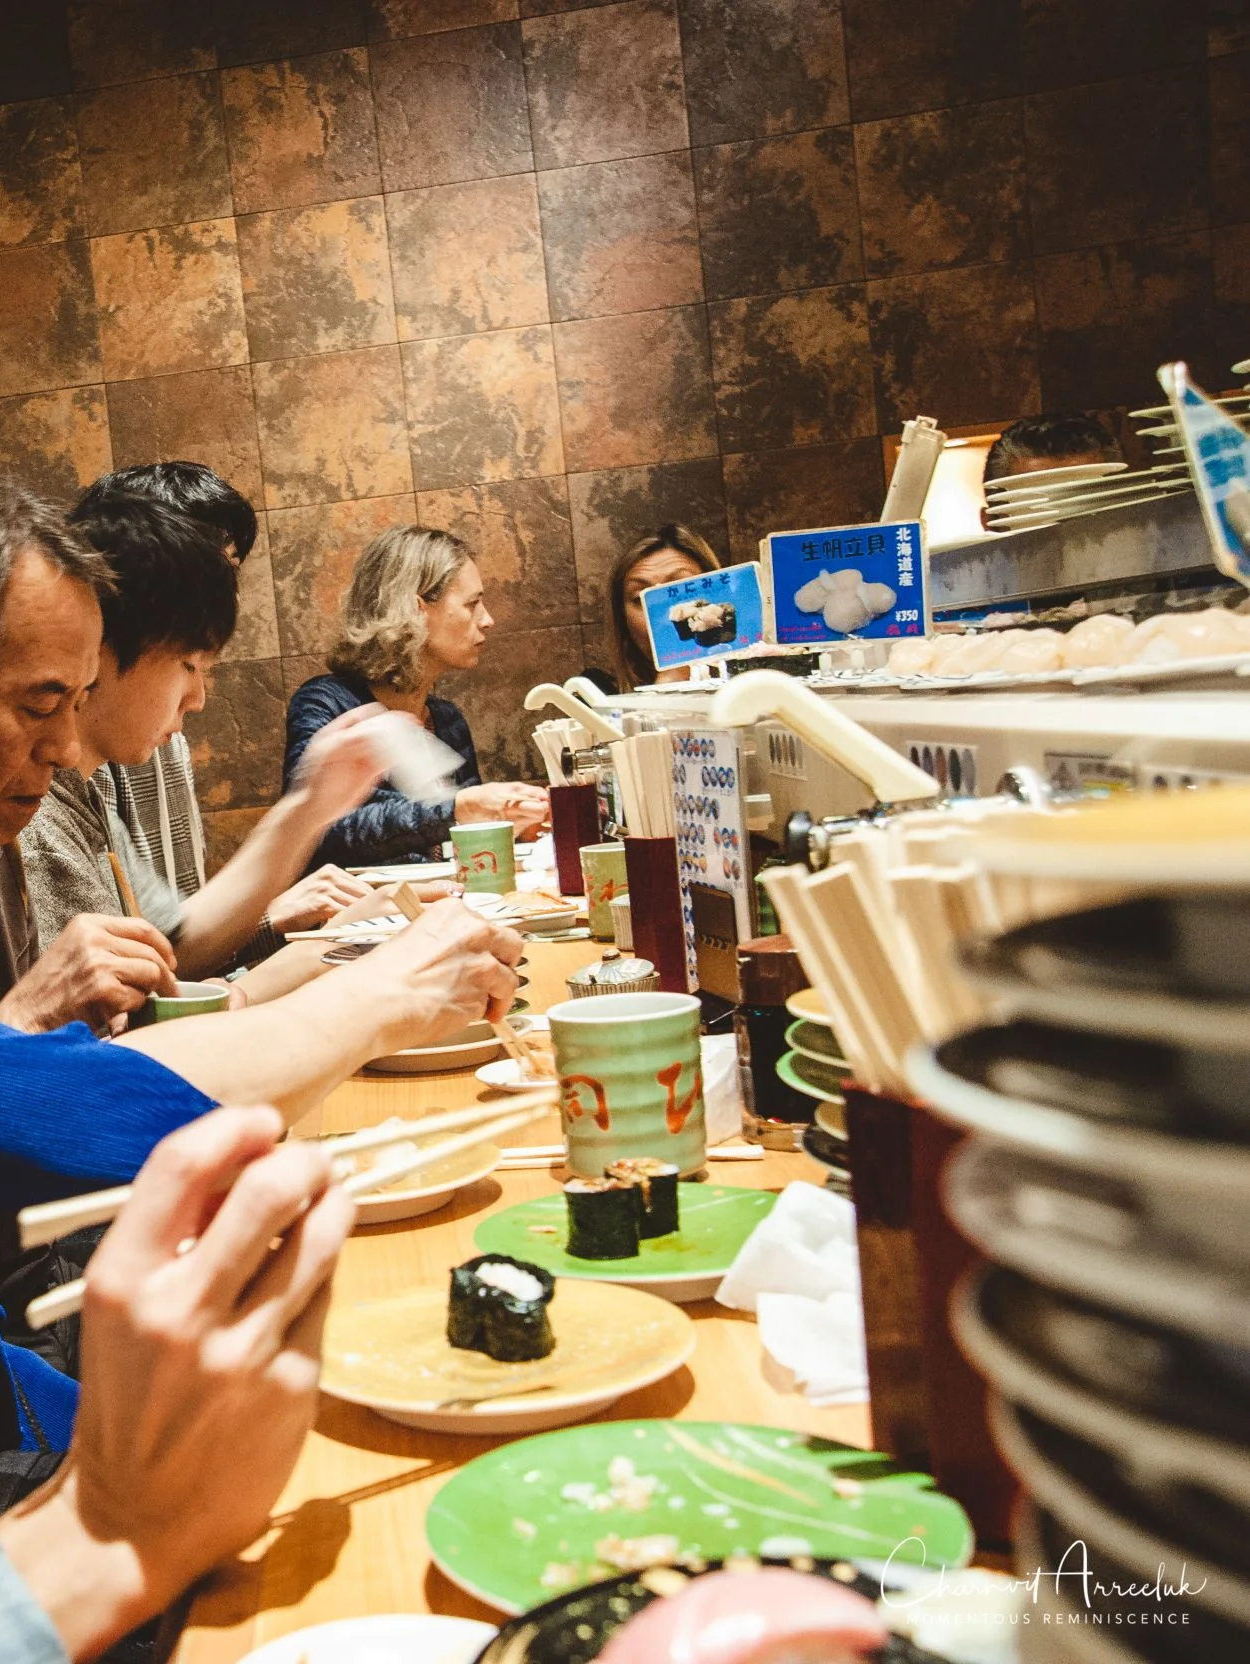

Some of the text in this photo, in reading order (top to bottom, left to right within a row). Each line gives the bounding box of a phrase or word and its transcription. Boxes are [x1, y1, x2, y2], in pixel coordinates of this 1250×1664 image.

[802, 533, 886, 562] 生帆立貝
[895, 526, 914, 587] 北海道産
[667, 572, 730, 597] かにみそ
[894, 609, 919, 623] ¥350
